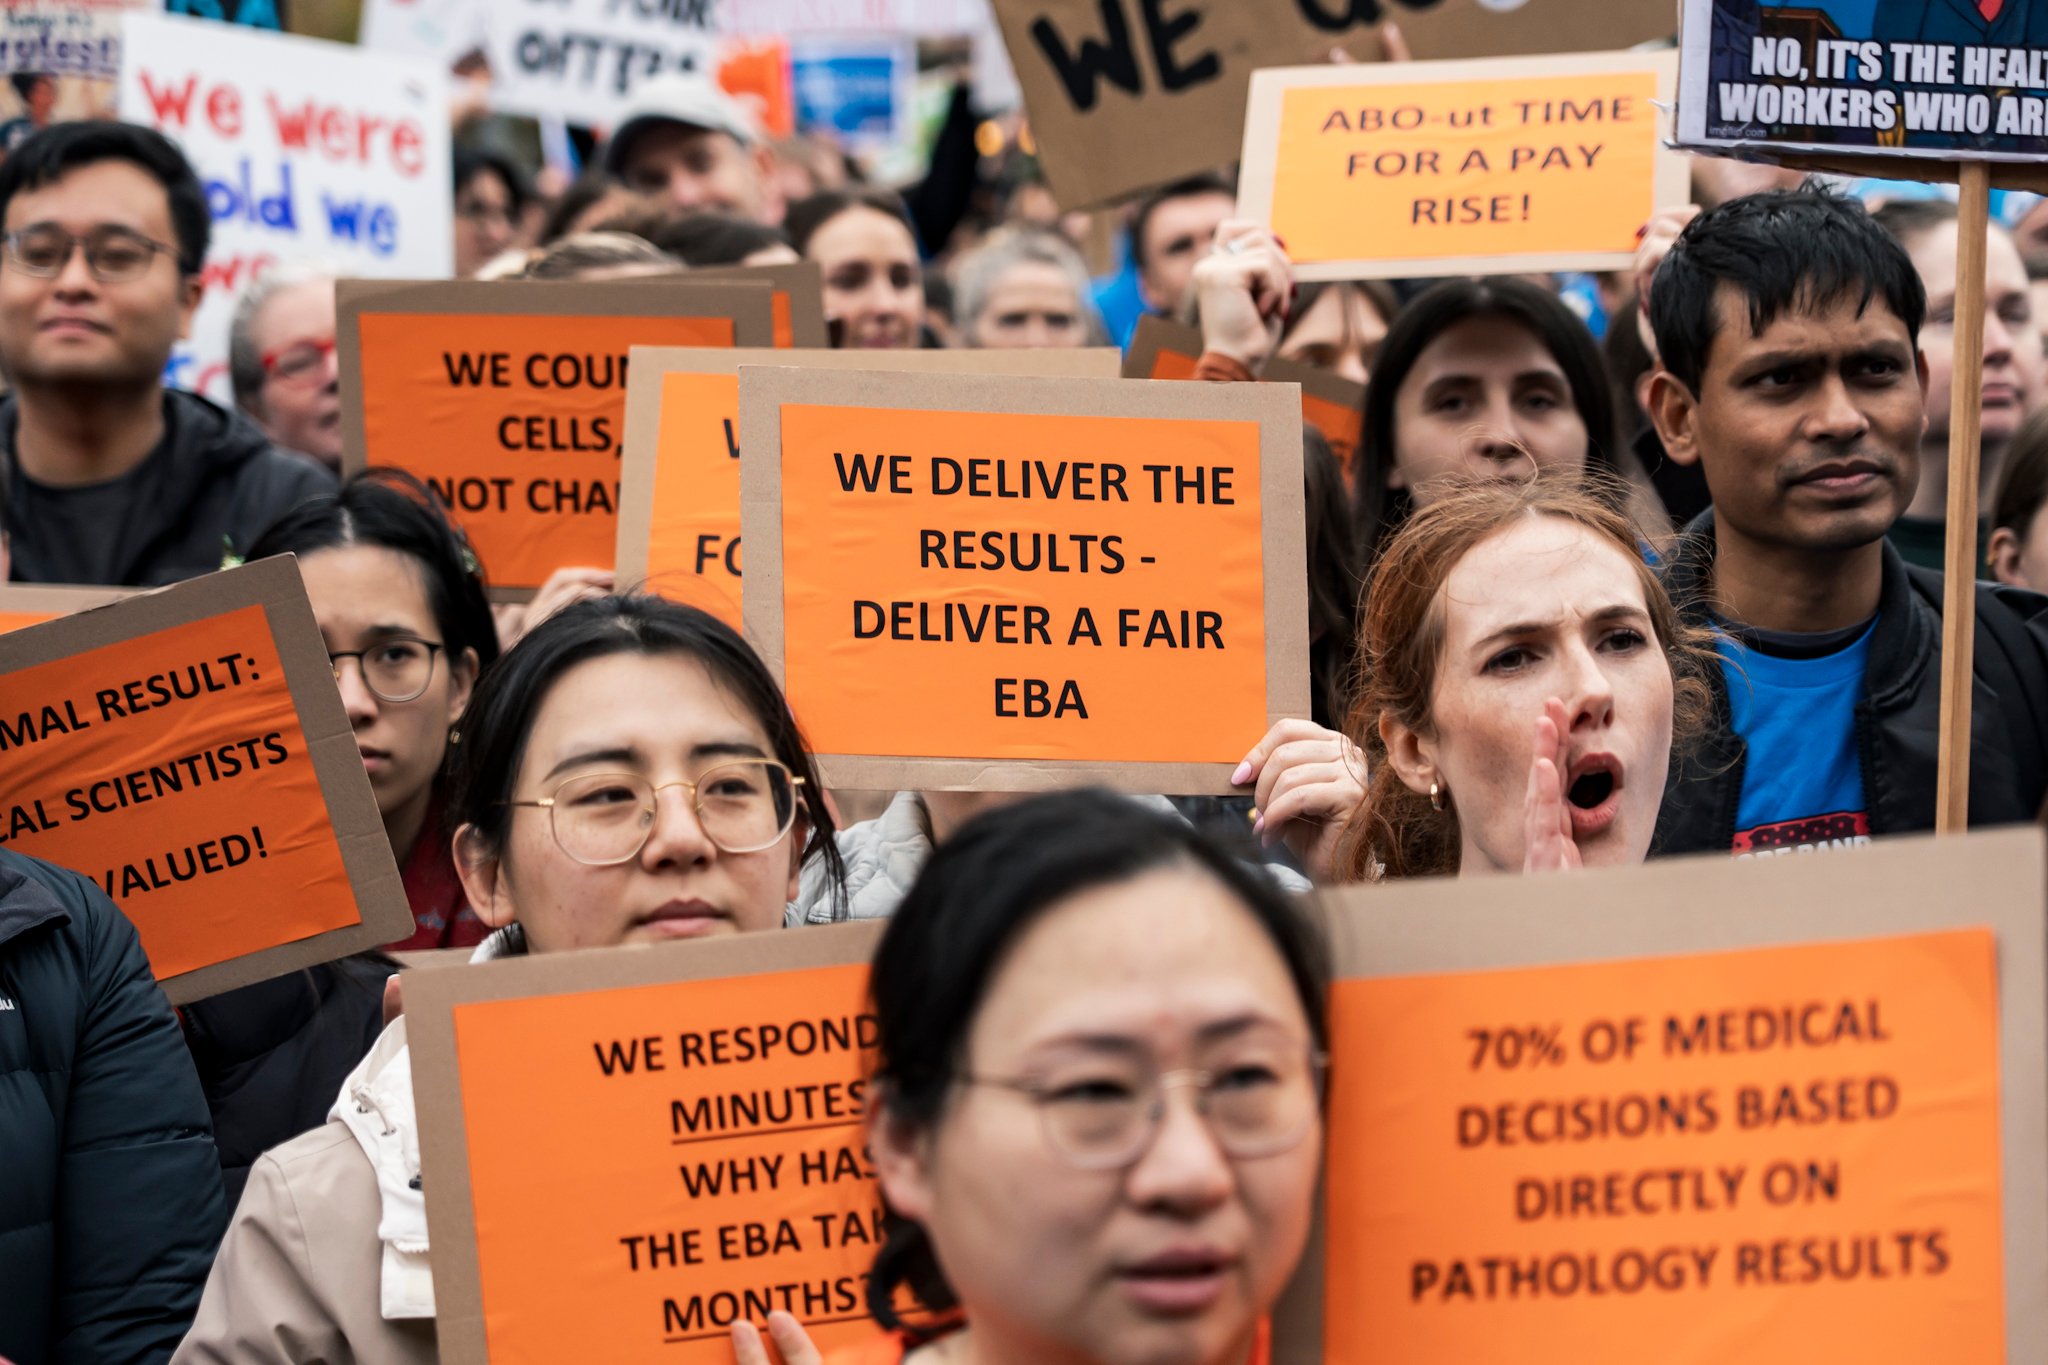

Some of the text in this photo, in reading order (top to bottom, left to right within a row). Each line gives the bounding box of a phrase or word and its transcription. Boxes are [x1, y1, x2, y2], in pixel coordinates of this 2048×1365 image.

[1031, 0, 1221, 112] WE
[1753, 38, 1807, 80] NO,
[1817, 41, 1881, 80] IT'S
[1891, 44, 1955, 83] THE
[1321, 96, 1633, 133] ABO-ut TIME
[1720, 84, 2048, 135] WORKERS WHO AR
[264, 92, 424, 178] were
[1348, 144, 1603, 176] FOR A PAY
[203, 156, 400, 261] old we
[1413, 194, 1529, 224] RISE!
[444, 353, 509, 387] WE
[427, 478, 620, 514] NOT CHA
[834, 453, 1234, 504] WE DELIVER THE
[921, 530, 1124, 574] RESULTS
[854, 601, 1224, 649] DELIVER A FAIR
[96, 652, 261, 722] RESULT:
[995, 679, 1088, 718] EBA
[65, 733, 288, 821] SCIENTISTS
[594, 1037, 663, 1075] WE
[1467, 1002, 1887, 1070] 70% OF MEDICAL
[1455, 1077, 1901, 1149] DECISIONS BASED
[681, 1155, 782, 1198] WHY
[1514, 1161, 1841, 1222] DIRECTLY ON
[621, 1230, 702, 1270] THE
[719, 1220, 800, 1260] EBA
[1408, 1230, 1952, 1304] PATHOLOGY RESULTS
